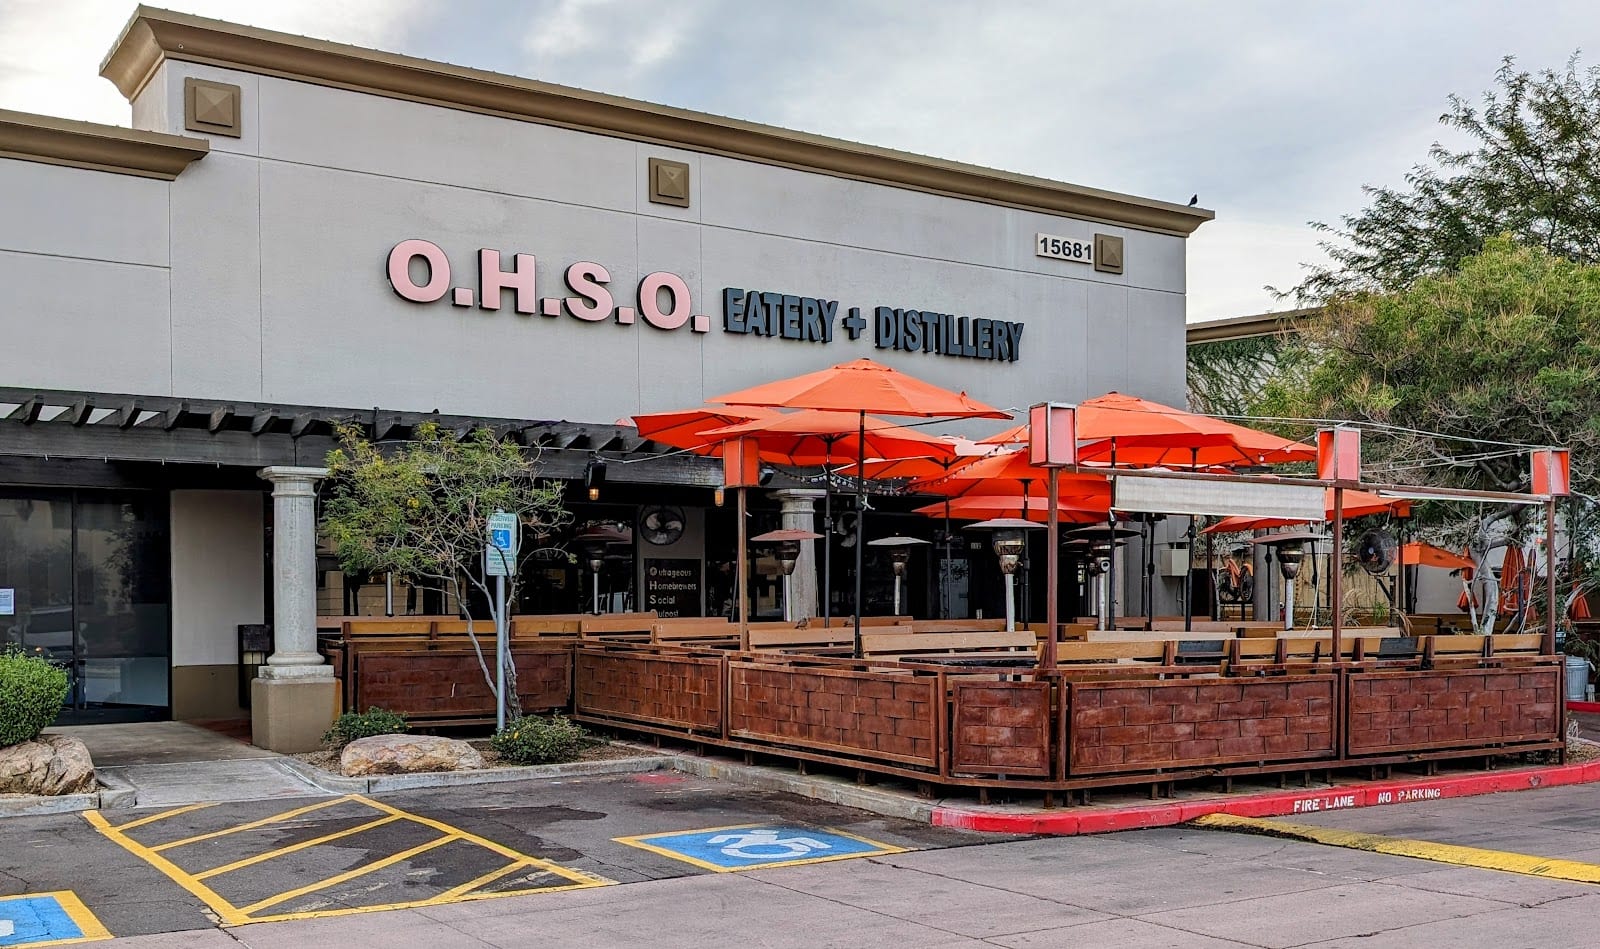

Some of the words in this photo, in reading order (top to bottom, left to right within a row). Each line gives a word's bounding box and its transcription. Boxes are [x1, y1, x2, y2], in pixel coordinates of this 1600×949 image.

[1040, 237, 1092, 260] 15681
[722, 287, 838, 343] EATERY
[874, 306, 1025, 362] DISTILLERY
[649, 594, 676, 604] Social
[1293, 798, 1320, 813] FIRE
[1325, 795, 1355, 809] LANE
[1378, 791, 1392, 804] NO
[1398, 788, 1441, 801] PARKING
